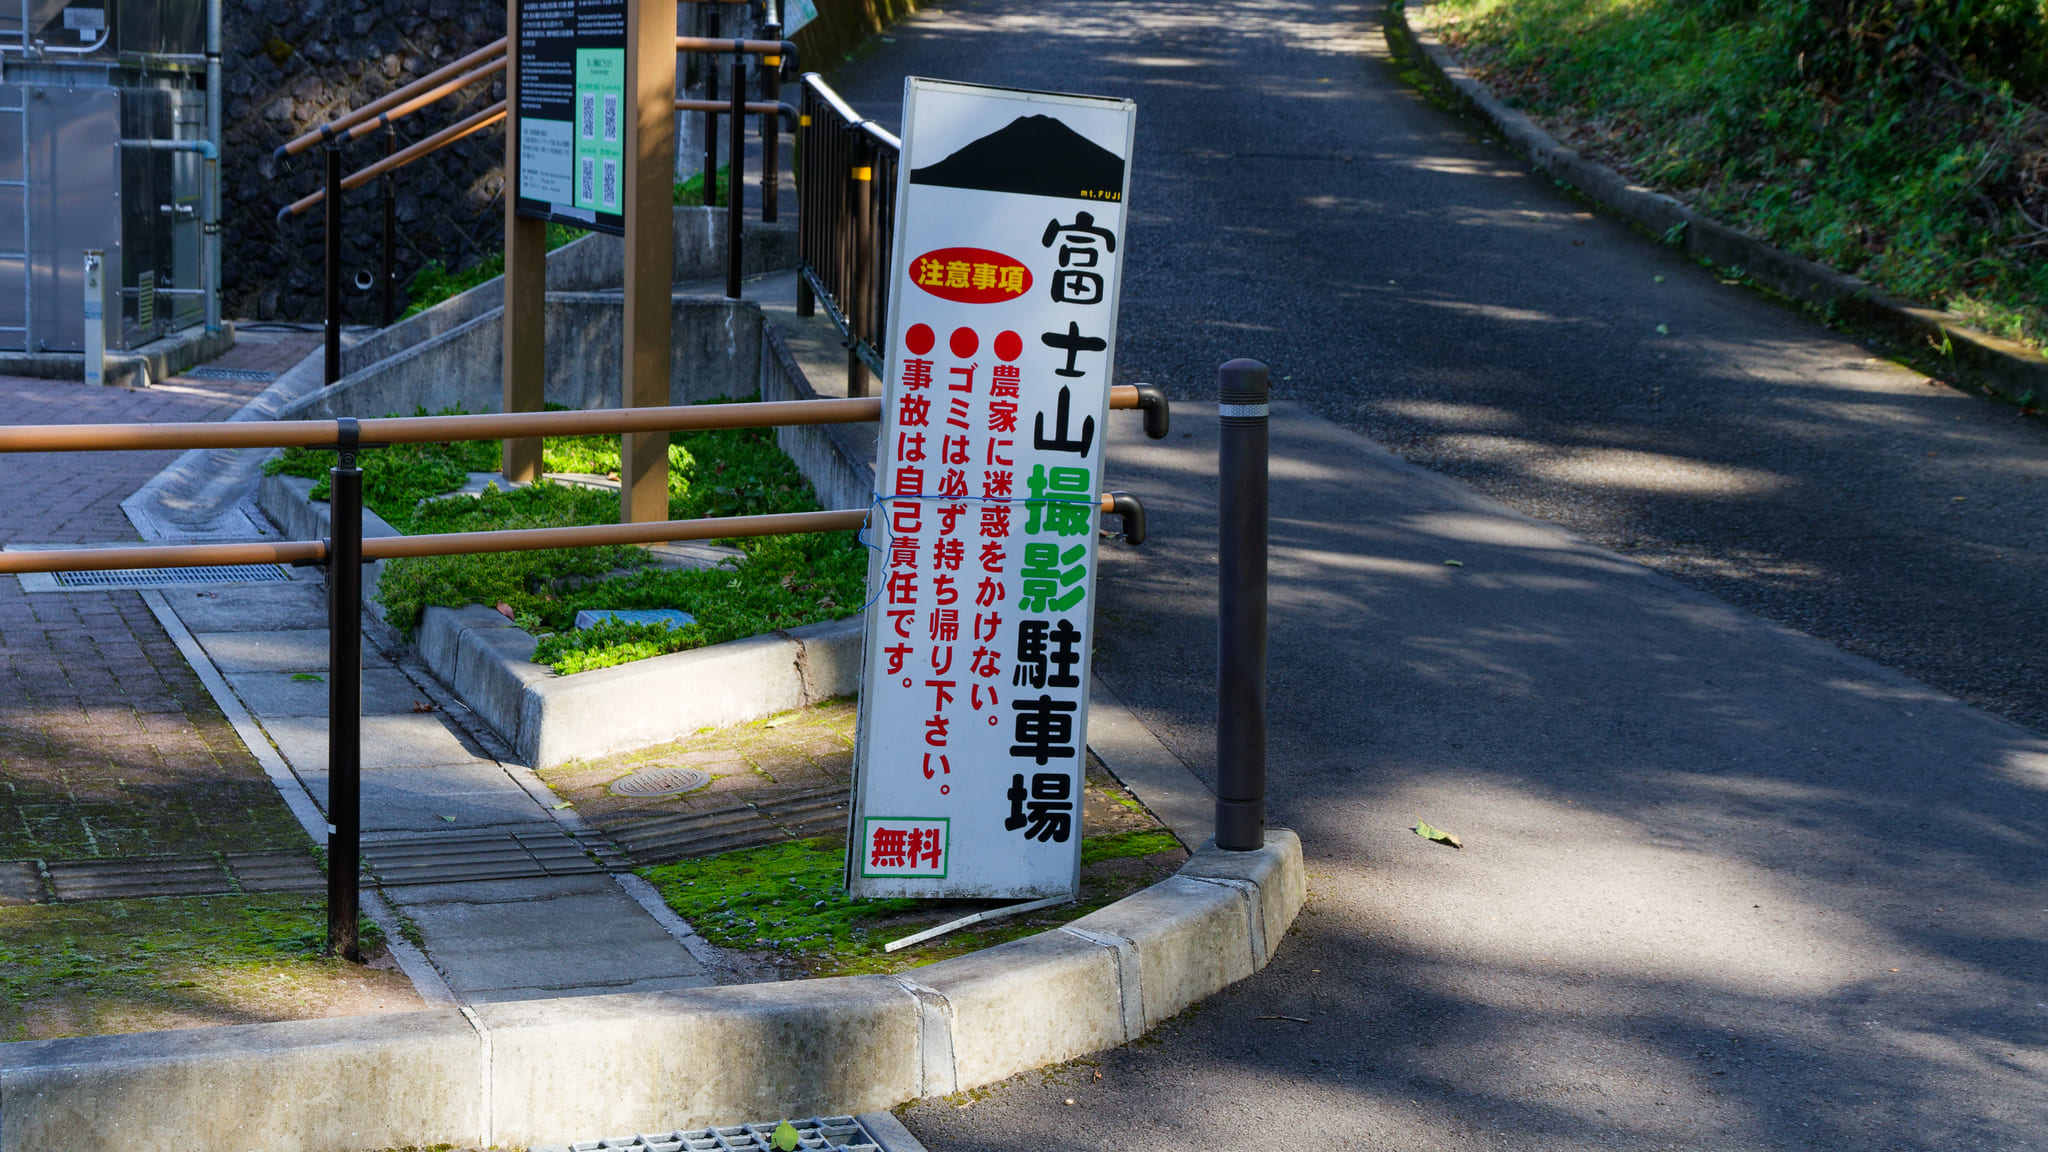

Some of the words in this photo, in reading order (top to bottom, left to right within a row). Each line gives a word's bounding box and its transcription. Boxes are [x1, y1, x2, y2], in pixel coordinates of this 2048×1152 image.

[917, 257, 1025, 295] 注意事項
[884, 358, 934, 689] 事故は自己責任です。
[922, 362, 979, 796] ゴミは必ず持ち帰り下さい。
[970, 364, 1021, 727] 農家に迷惑をかけない。
[1005, 211, 1116, 843] 富士山撮影駐車場
[871, 827, 943, 869] 無料
